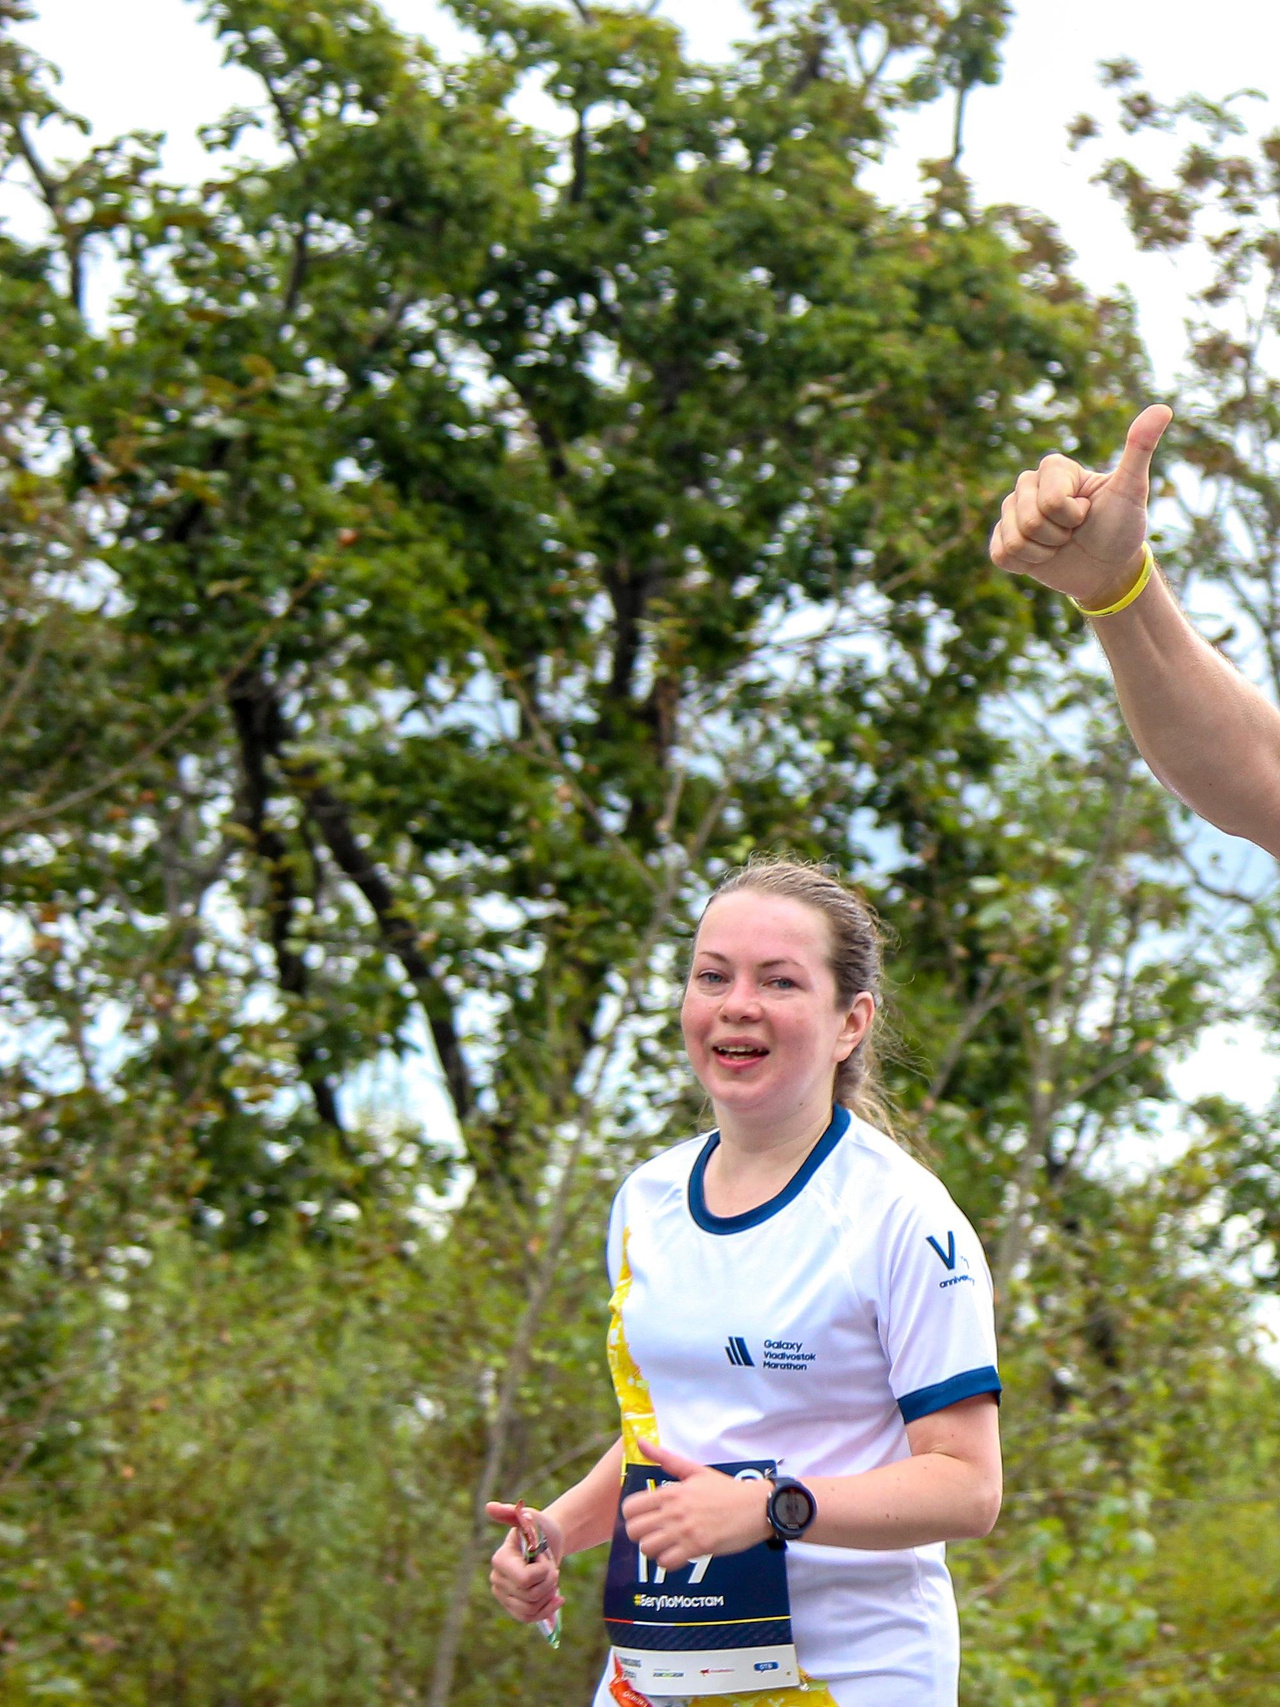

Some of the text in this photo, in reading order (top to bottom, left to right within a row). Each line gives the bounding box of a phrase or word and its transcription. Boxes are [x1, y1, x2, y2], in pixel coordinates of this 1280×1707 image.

[926, 1231, 955, 1270] V
[764, 1339, 803, 1353] Galaxy
[764, 1351, 816, 1361] Vladivostok
[763, 1360, 807, 1370] Marathon
[634, 1594, 724, 1611] #БегуПоМостам
